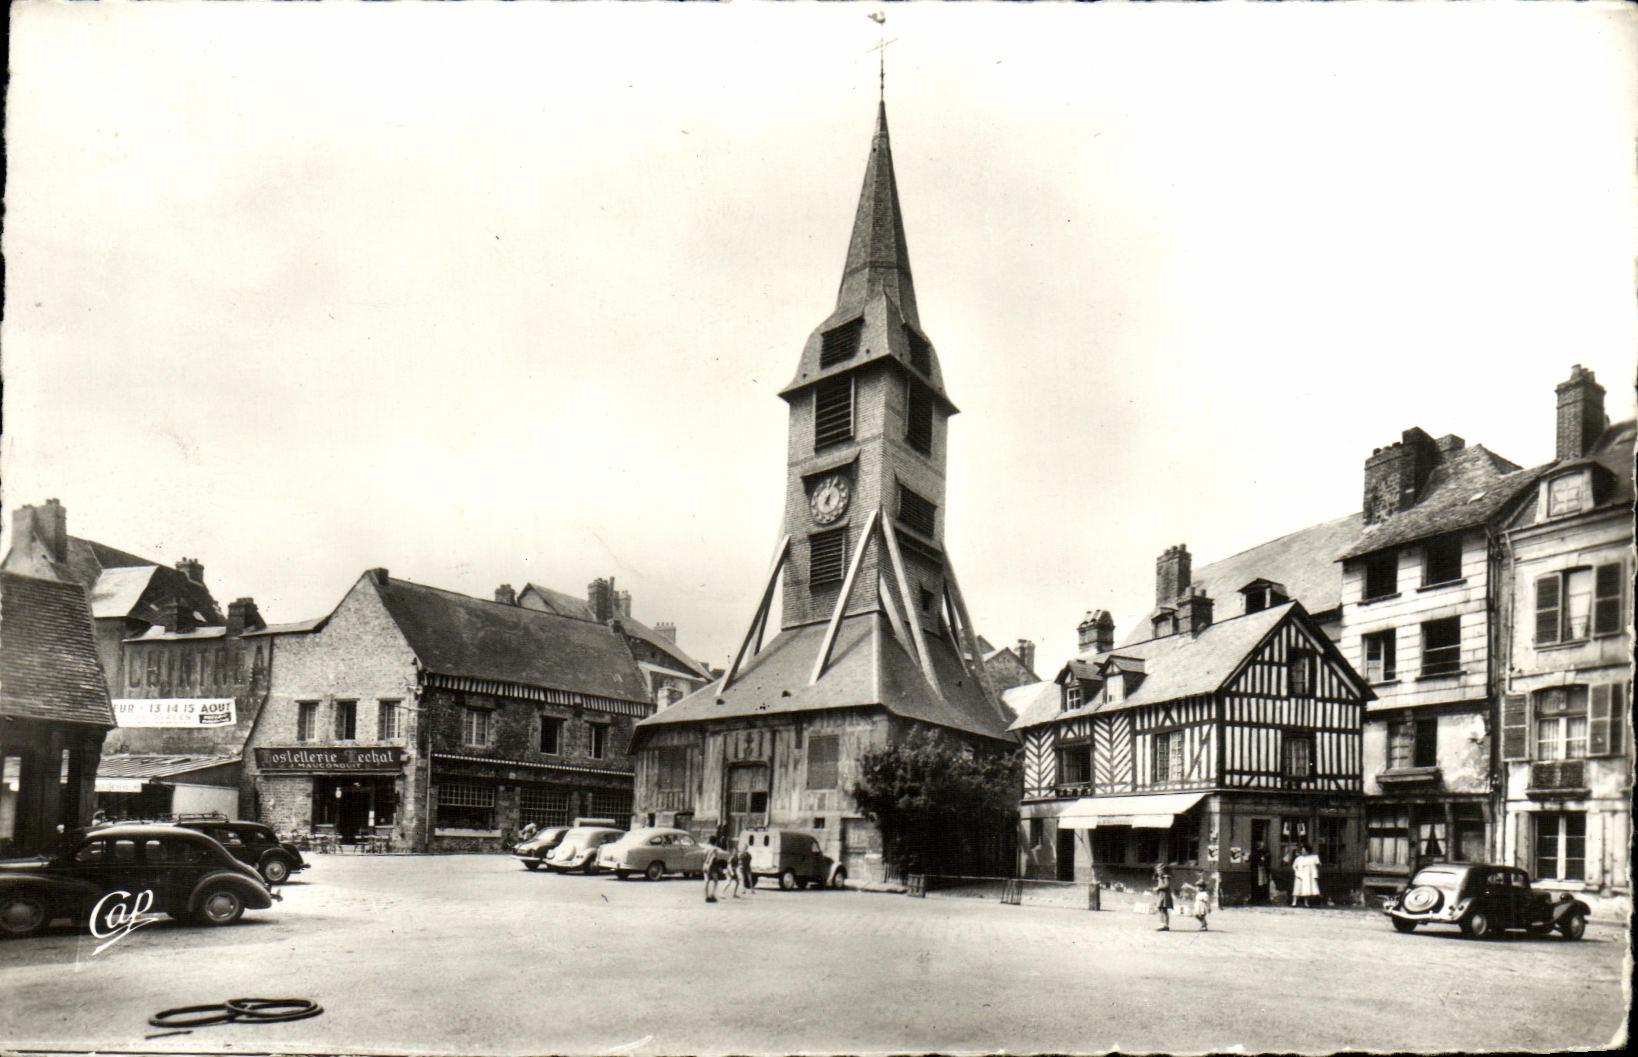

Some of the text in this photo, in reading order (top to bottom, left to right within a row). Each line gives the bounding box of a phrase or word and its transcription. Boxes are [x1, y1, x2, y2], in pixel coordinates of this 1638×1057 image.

[149, 703, 162, 713] 13
[166, 703, 179, 713] 14
[183, 703, 196, 713] 15
